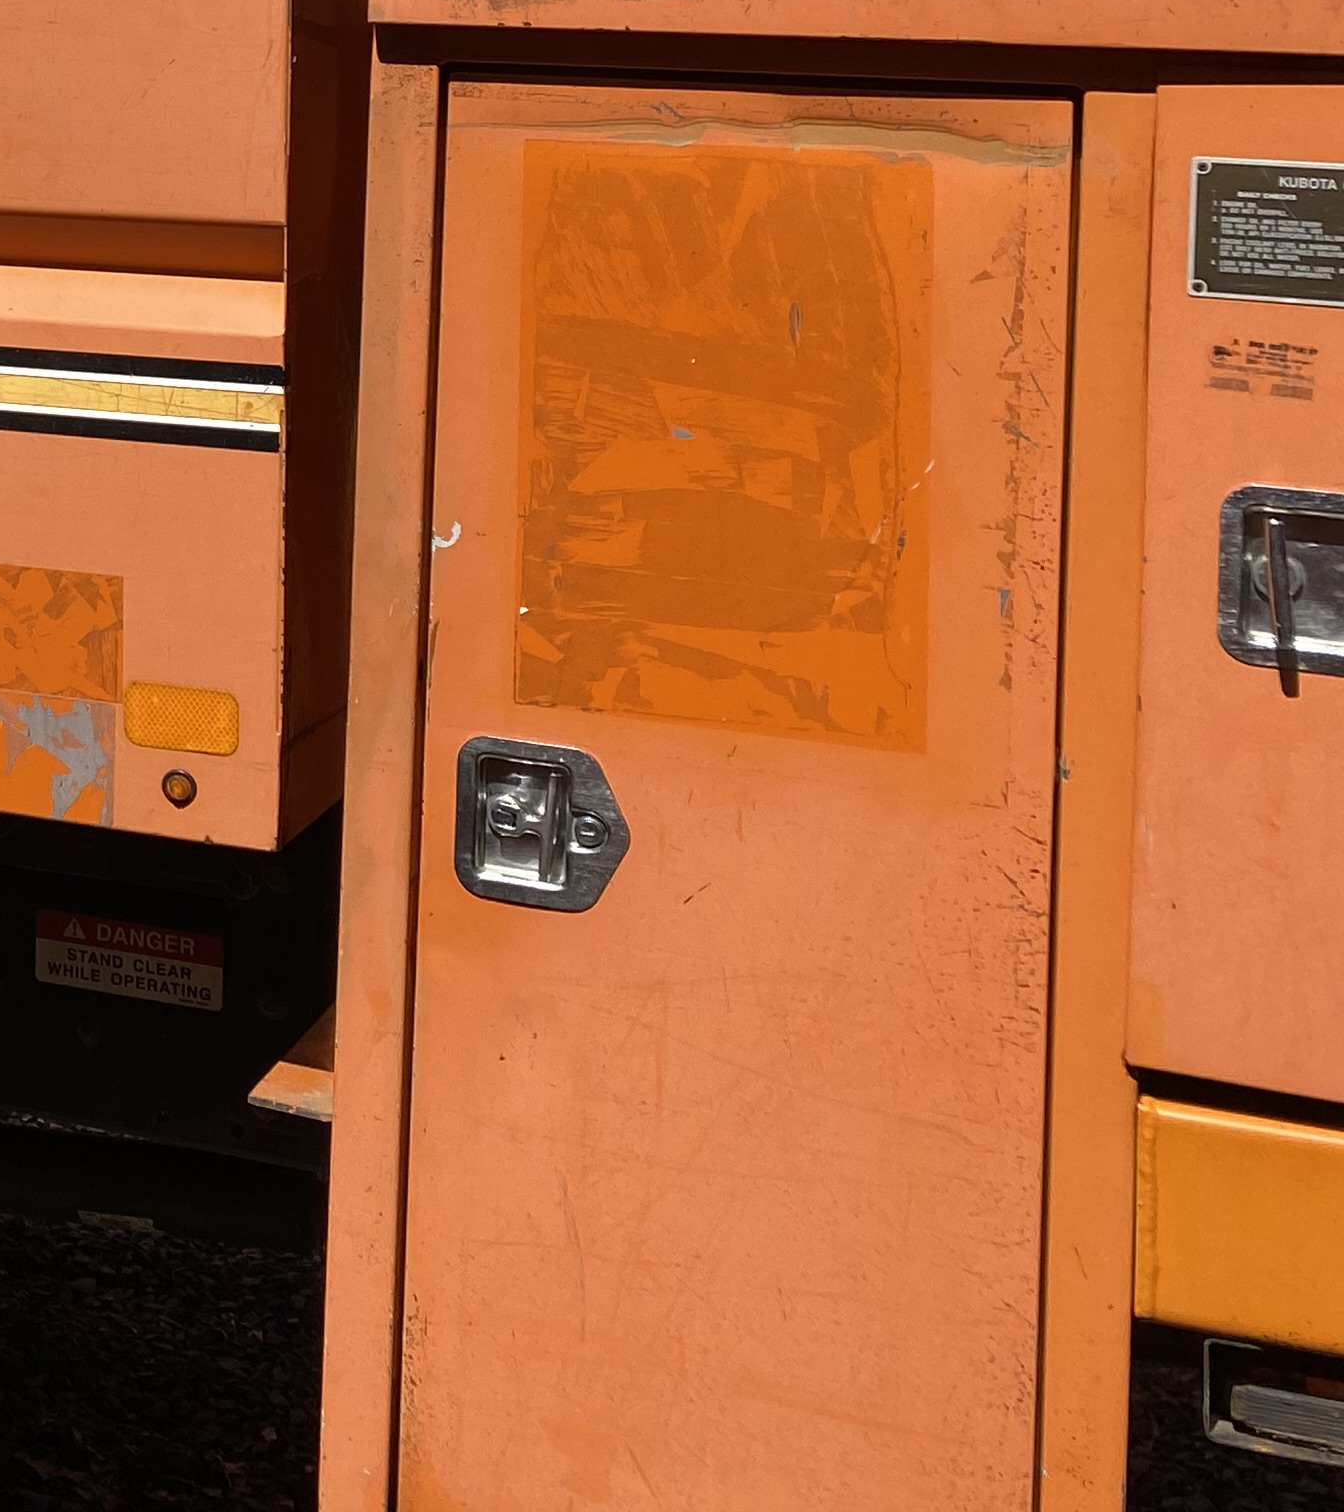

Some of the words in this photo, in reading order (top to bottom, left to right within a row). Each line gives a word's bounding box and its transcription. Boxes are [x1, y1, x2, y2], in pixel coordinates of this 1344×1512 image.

[1279, 176, 1338, 190] KUBOTA
[97, 923, 195, 956] DANGER
[66, 948, 123, 969] STAND
[133, 959, 192, 980] CLEAR
[47, 961, 101, 982] WHILE
[111, 973, 212, 1001] OPERATING
